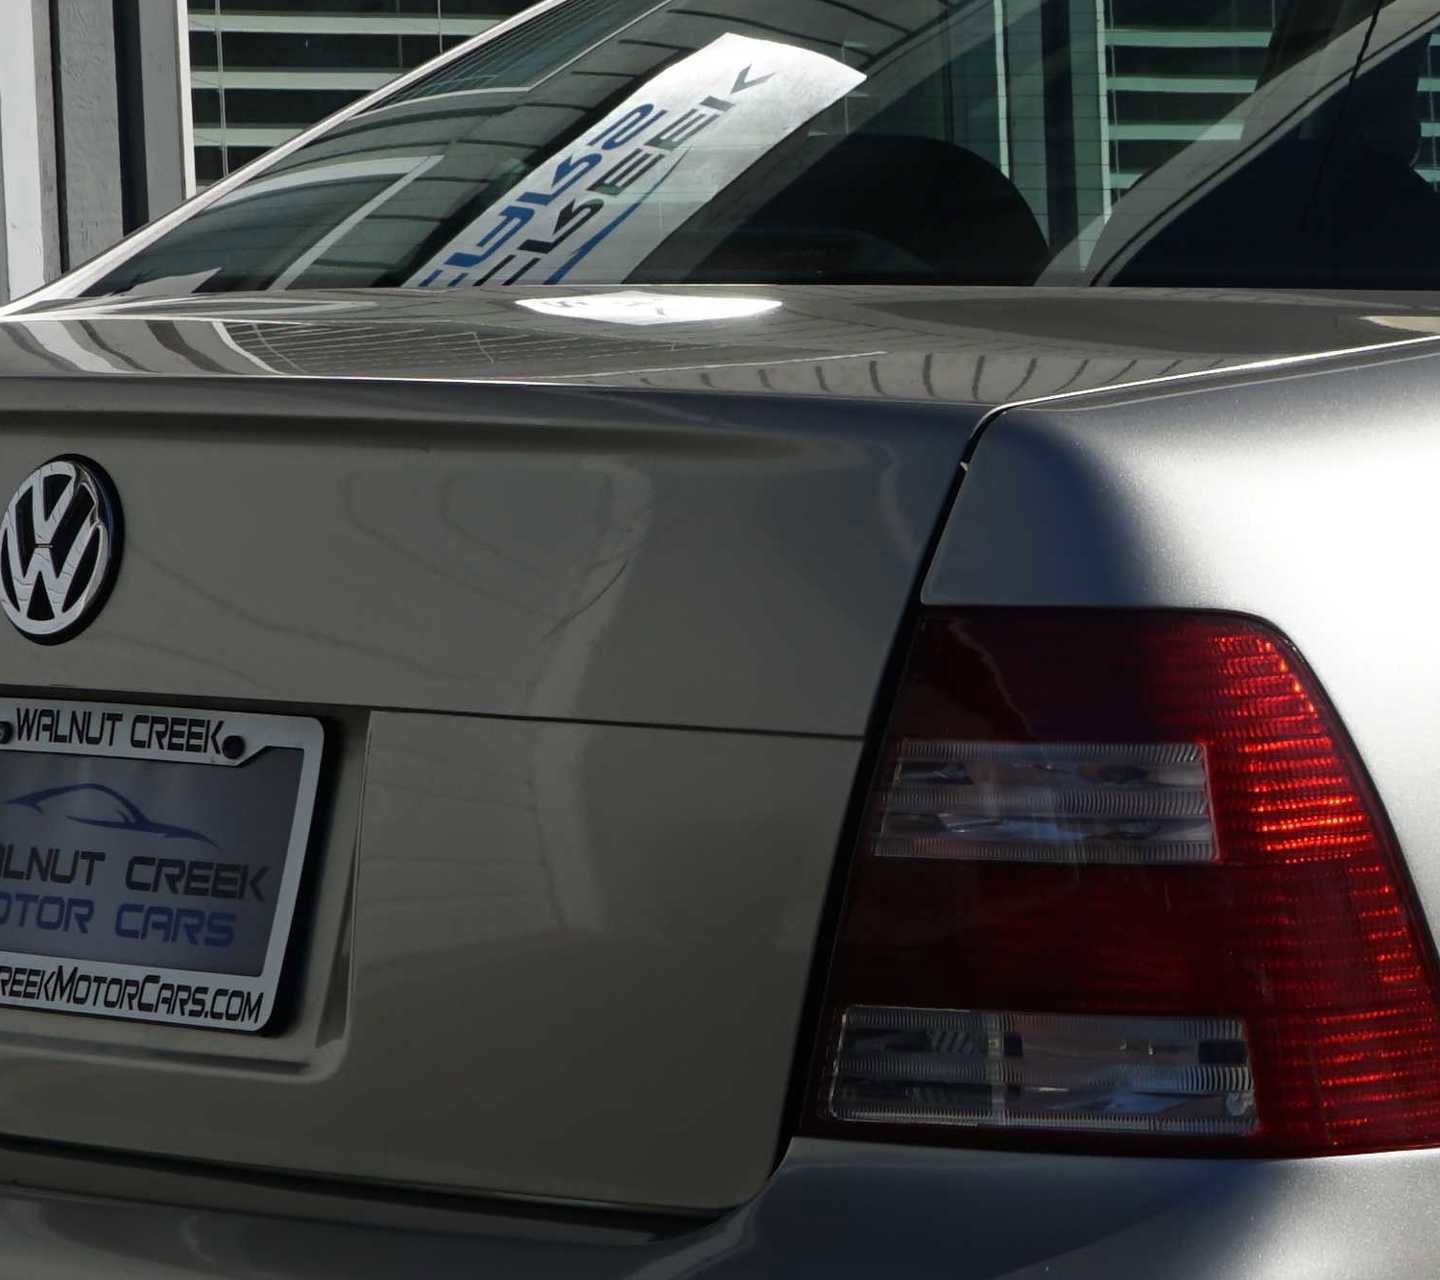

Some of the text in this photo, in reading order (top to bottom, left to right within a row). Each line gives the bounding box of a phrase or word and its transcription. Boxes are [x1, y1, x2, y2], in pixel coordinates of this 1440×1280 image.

[15, 707, 226, 756] WALNUT CREEK
[124, 855, 273, 903] CREEK
[114, 902, 237, 948] CARS
